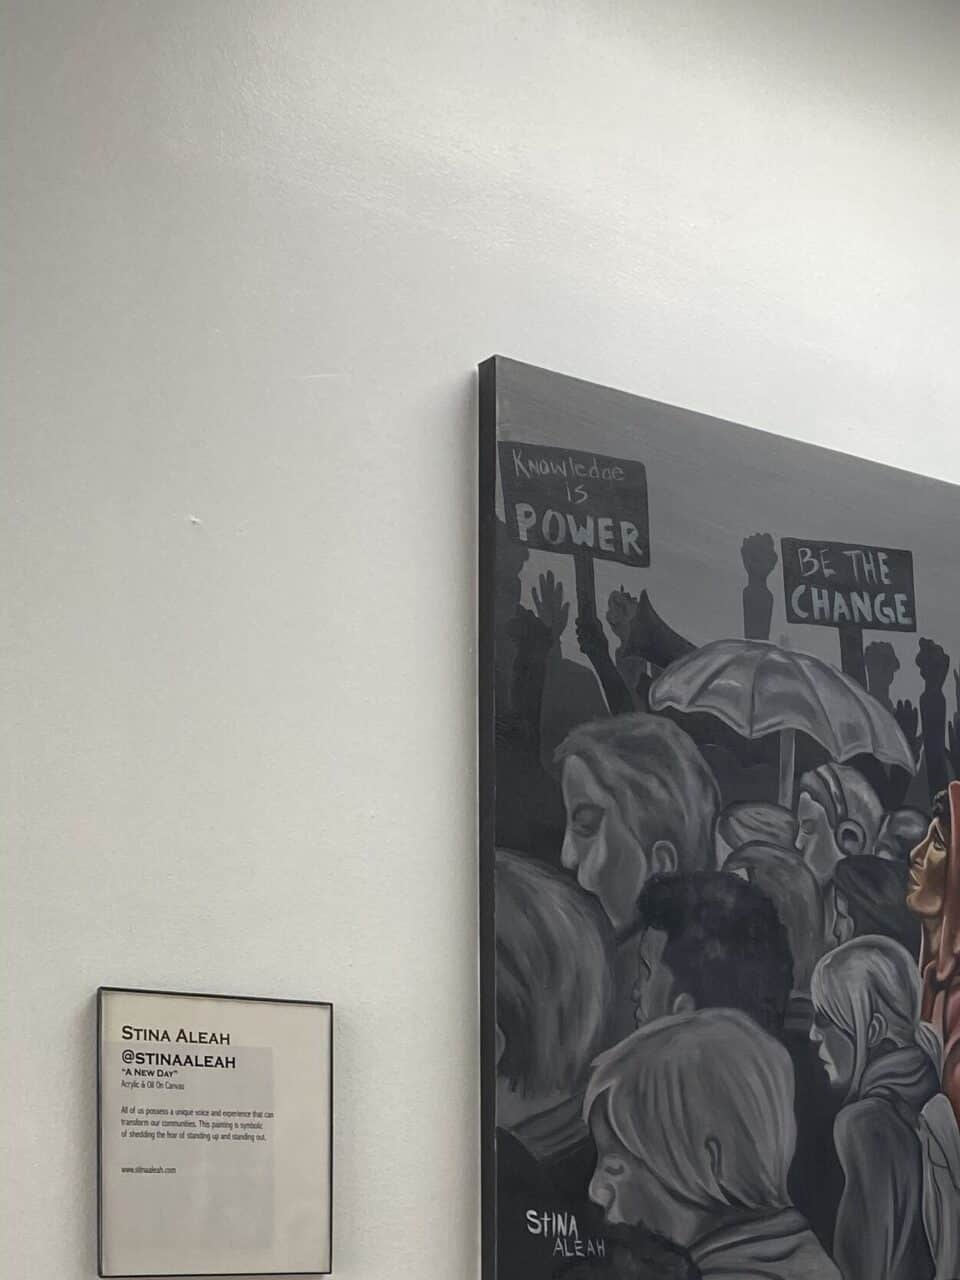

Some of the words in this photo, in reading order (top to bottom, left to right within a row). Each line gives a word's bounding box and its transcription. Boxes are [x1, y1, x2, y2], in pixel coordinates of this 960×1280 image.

[515, 502, 644, 556] POWER
[798, 547, 837, 578] BE
[842, 549, 892, 585] THE
[791, 584, 913, 625] CHANGE
[552, 1237, 606, 1257] ALEAH
